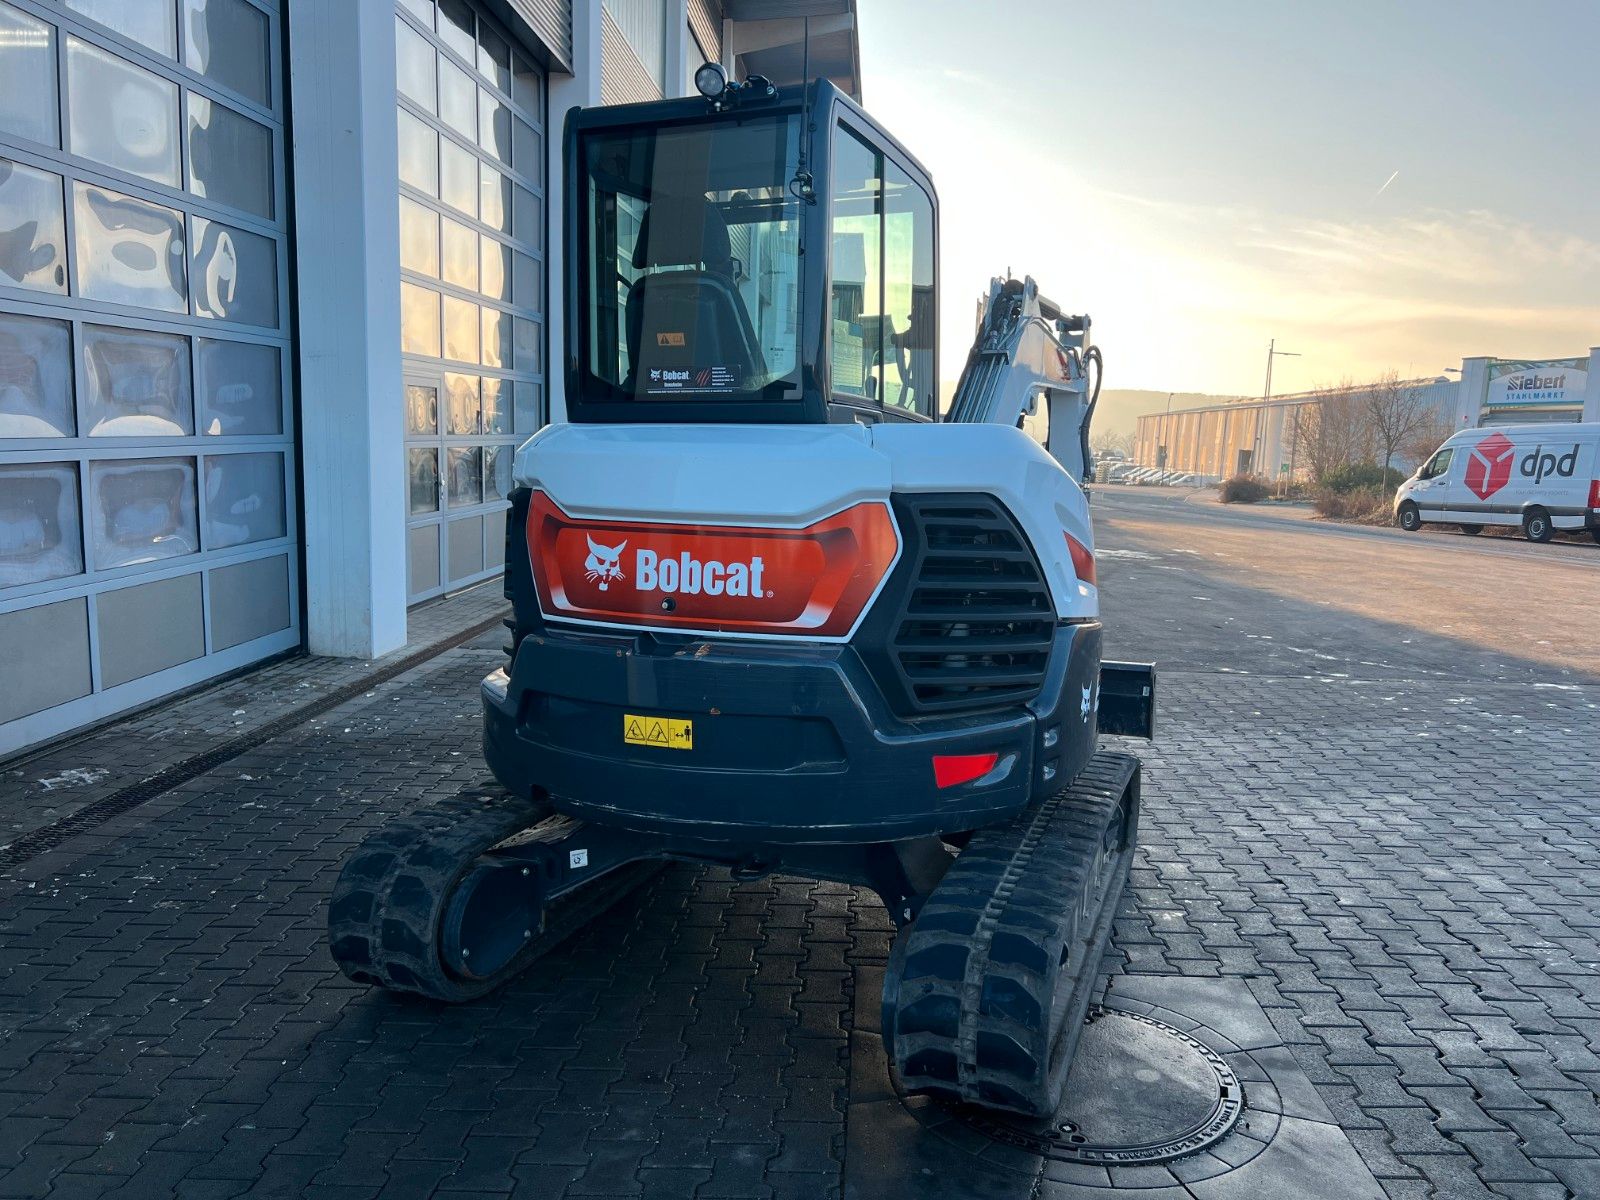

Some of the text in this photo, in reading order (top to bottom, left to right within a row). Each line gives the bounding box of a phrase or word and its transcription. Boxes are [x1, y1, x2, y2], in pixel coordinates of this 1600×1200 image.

[663, 370, 690, 380] Bobcat
[1507, 374, 1566, 391] Siebert
[1506, 391, 1565, 400] STAHLMARKT
[1520, 443, 1580, 485] dpd
[635, 548, 764, 598] Bobcat
